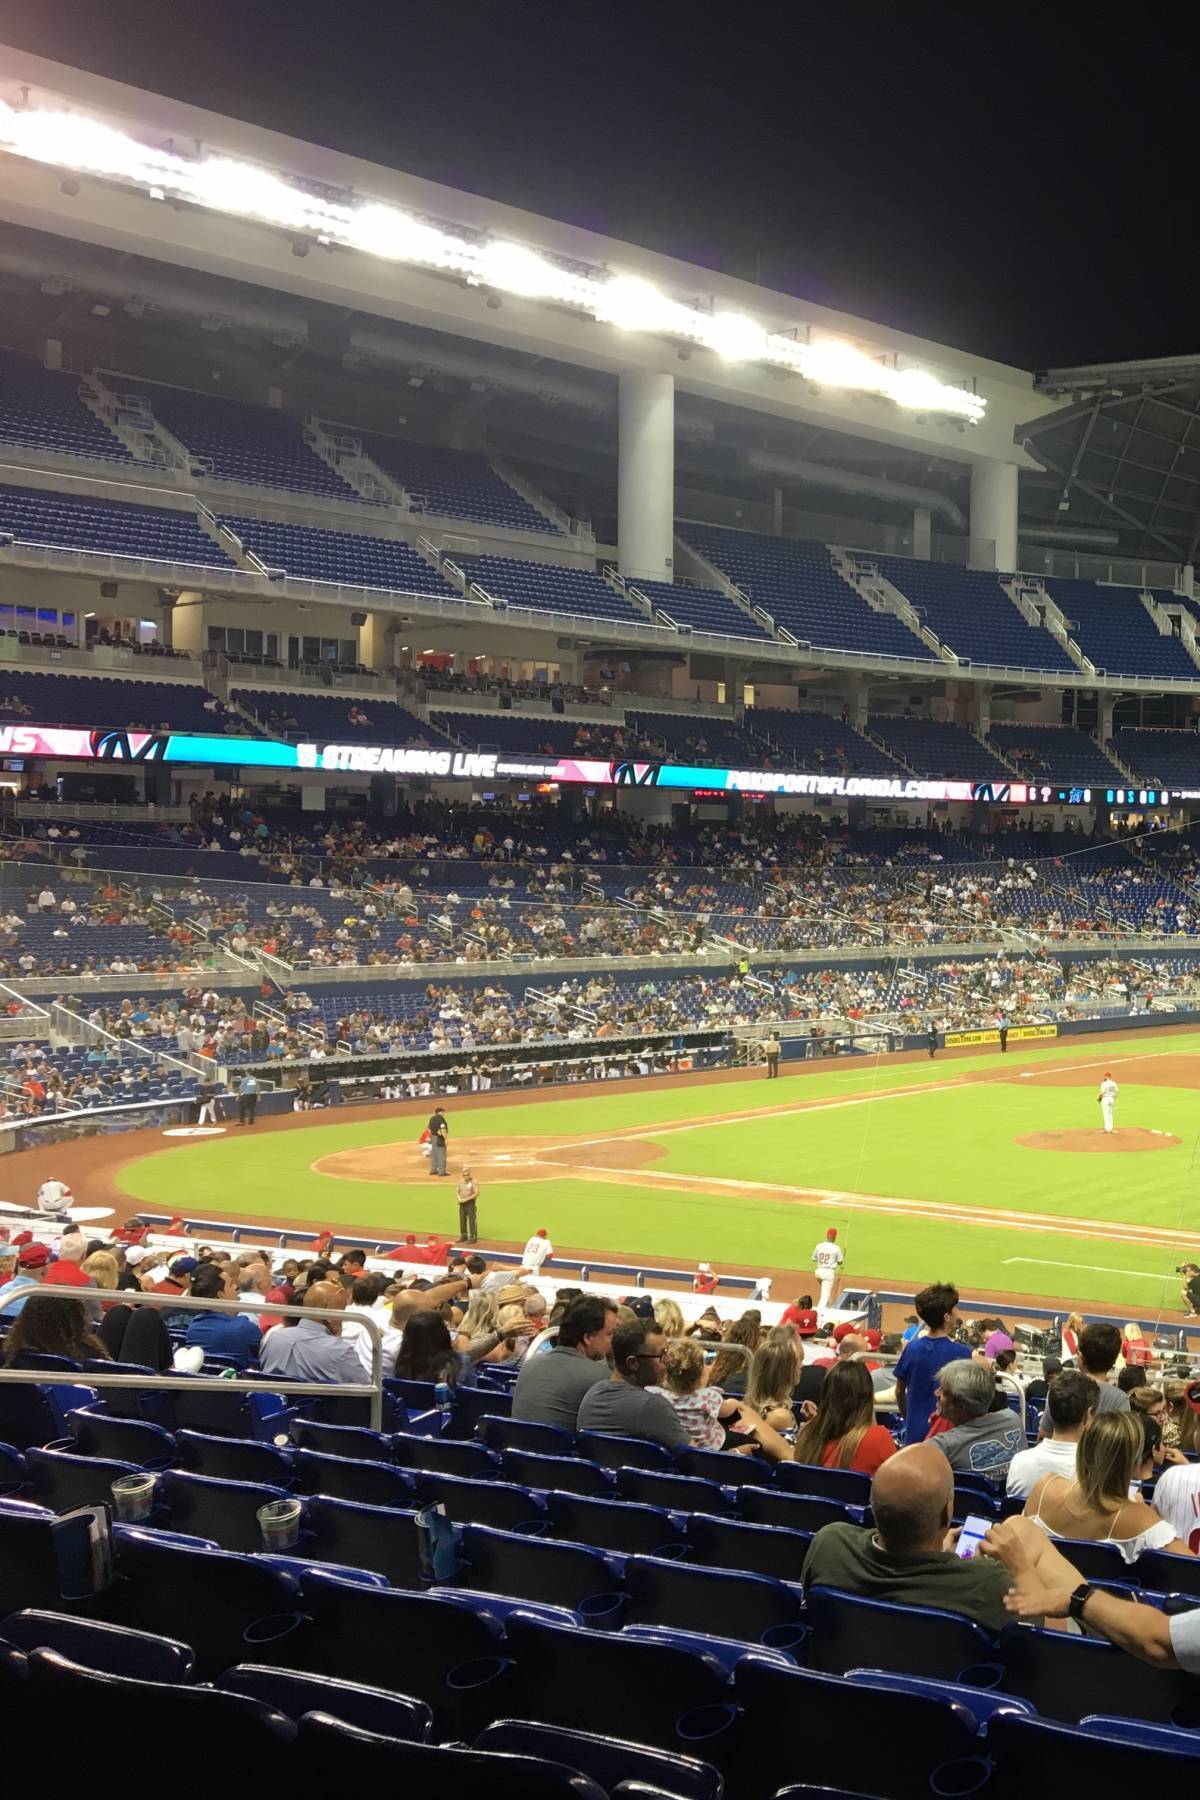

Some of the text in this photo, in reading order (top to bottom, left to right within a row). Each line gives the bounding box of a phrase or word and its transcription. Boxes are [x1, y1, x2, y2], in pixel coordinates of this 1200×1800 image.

[323, 745, 451, 776] STREAMING
[452, 753, 498, 778] LIVE
[727, 770, 945, 799] FOXSPORTSFLORIDA.COM
